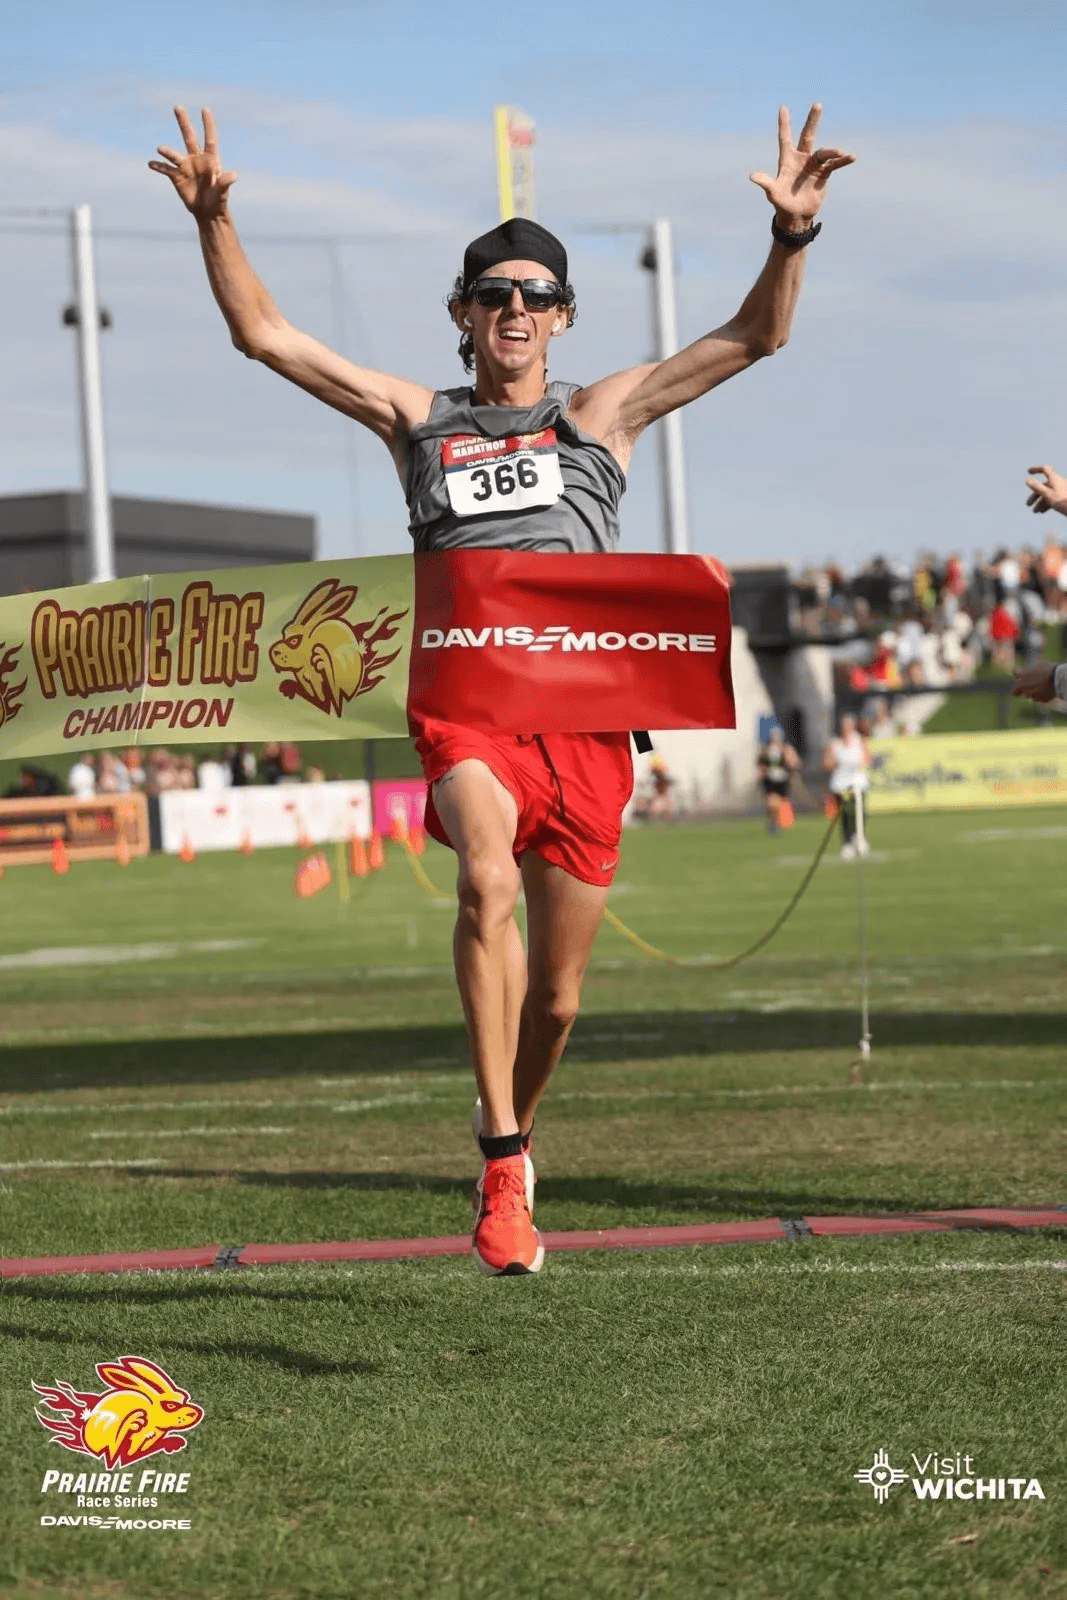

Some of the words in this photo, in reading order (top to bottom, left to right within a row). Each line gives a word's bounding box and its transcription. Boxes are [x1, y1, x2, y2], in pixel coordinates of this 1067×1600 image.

[451, 439, 507, 459] MARATHON
[470, 458, 539, 502] 366
[31, 598, 175, 699] PRAIRIE
[177, 581, 265, 687] FIRE
[62, 697, 235, 739] CHAMPION
